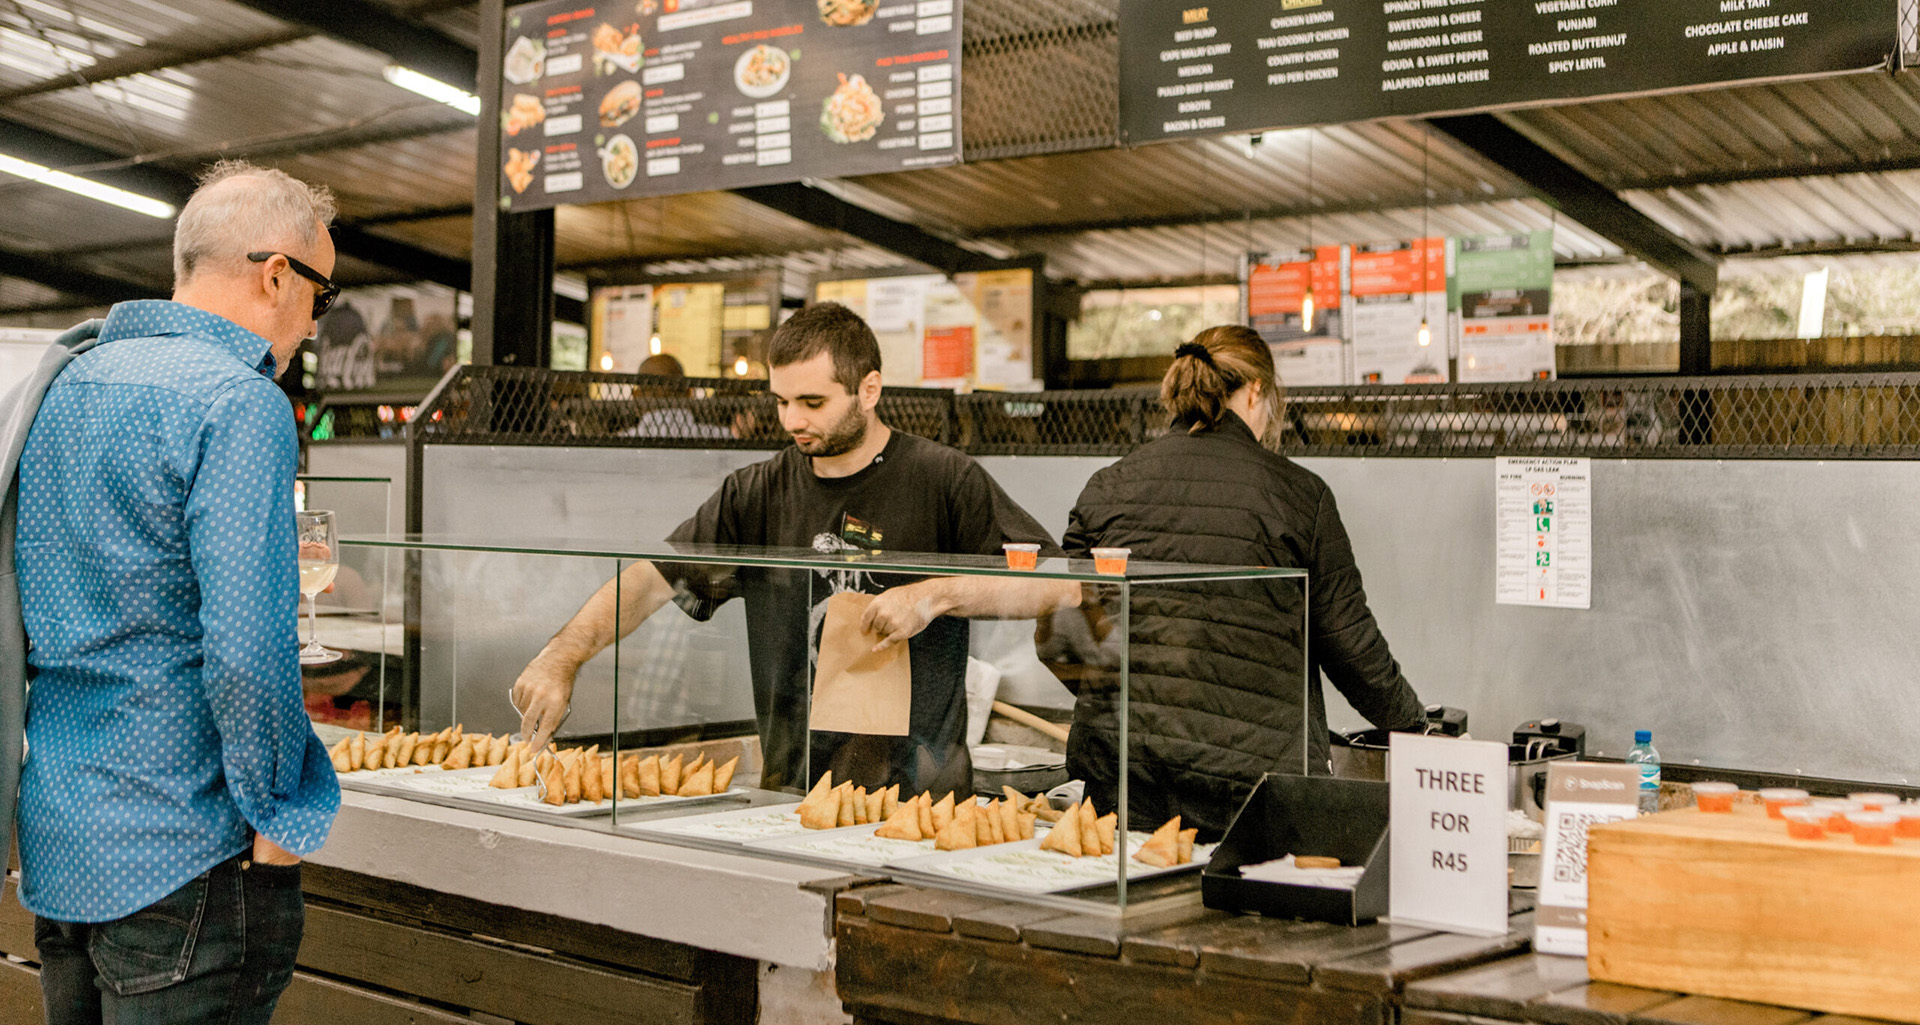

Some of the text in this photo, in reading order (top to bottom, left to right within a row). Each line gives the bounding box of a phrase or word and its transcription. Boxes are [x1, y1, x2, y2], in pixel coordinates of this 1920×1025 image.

[1183, 7, 1208, 23] MEAT
[1383, 0, 1420, 14] SPINACH
[1535, 0, 1587, 14] VEGETABLE
[1720, 0, 1770, 13] MILK TART
[1270, 10, 1334, 30] CHICKEN LEMON
[1387, 9, 1482, 33] SWEETCORN & CHEESE
[1557, 16, 1597, 32] PUNJABI
[1684, 12, 1809, 38] CHOCOLATE CHEESE CAKE
[1174, 30, 1193, 42] BEEF
[1257, 27, 1349, 50] THAI COCONUT CHICKEN
[1387, 29, 1483, 52] MUSHROOM & CHEESE
[1528, 33, 1627, 56] ROASTED BUTTERNUT
[1160, 43, 1232, 62] CAPE MALAY CURRY
[1707, 36, 1785, 57] APPLE & RAISIN
[1266, 47, 1339, 67] COUNTRY CHICKEN
[1382, 49, 1489, 72] GOUDA & SWEET PEPPER
[1548, 56, 1606, 74] SPICY LENTIL
[1178, 63, 1213, 77] MEXICAN
[1267, 66, 1338, 85] PERI PERI CHICKEN
[1382, 69, 1490, 91] JALAPENO CREAM CHEESE
[1157, 78, 1234, 98] PULLED BEEF BRISKET
[1163, 115, 1226, 133] BACON & CHEESE
[1416, 768, 1485, 795] THREE
[1431, 811, 1471, 834] FOR
[1432, 850, 1469, 872] R45
